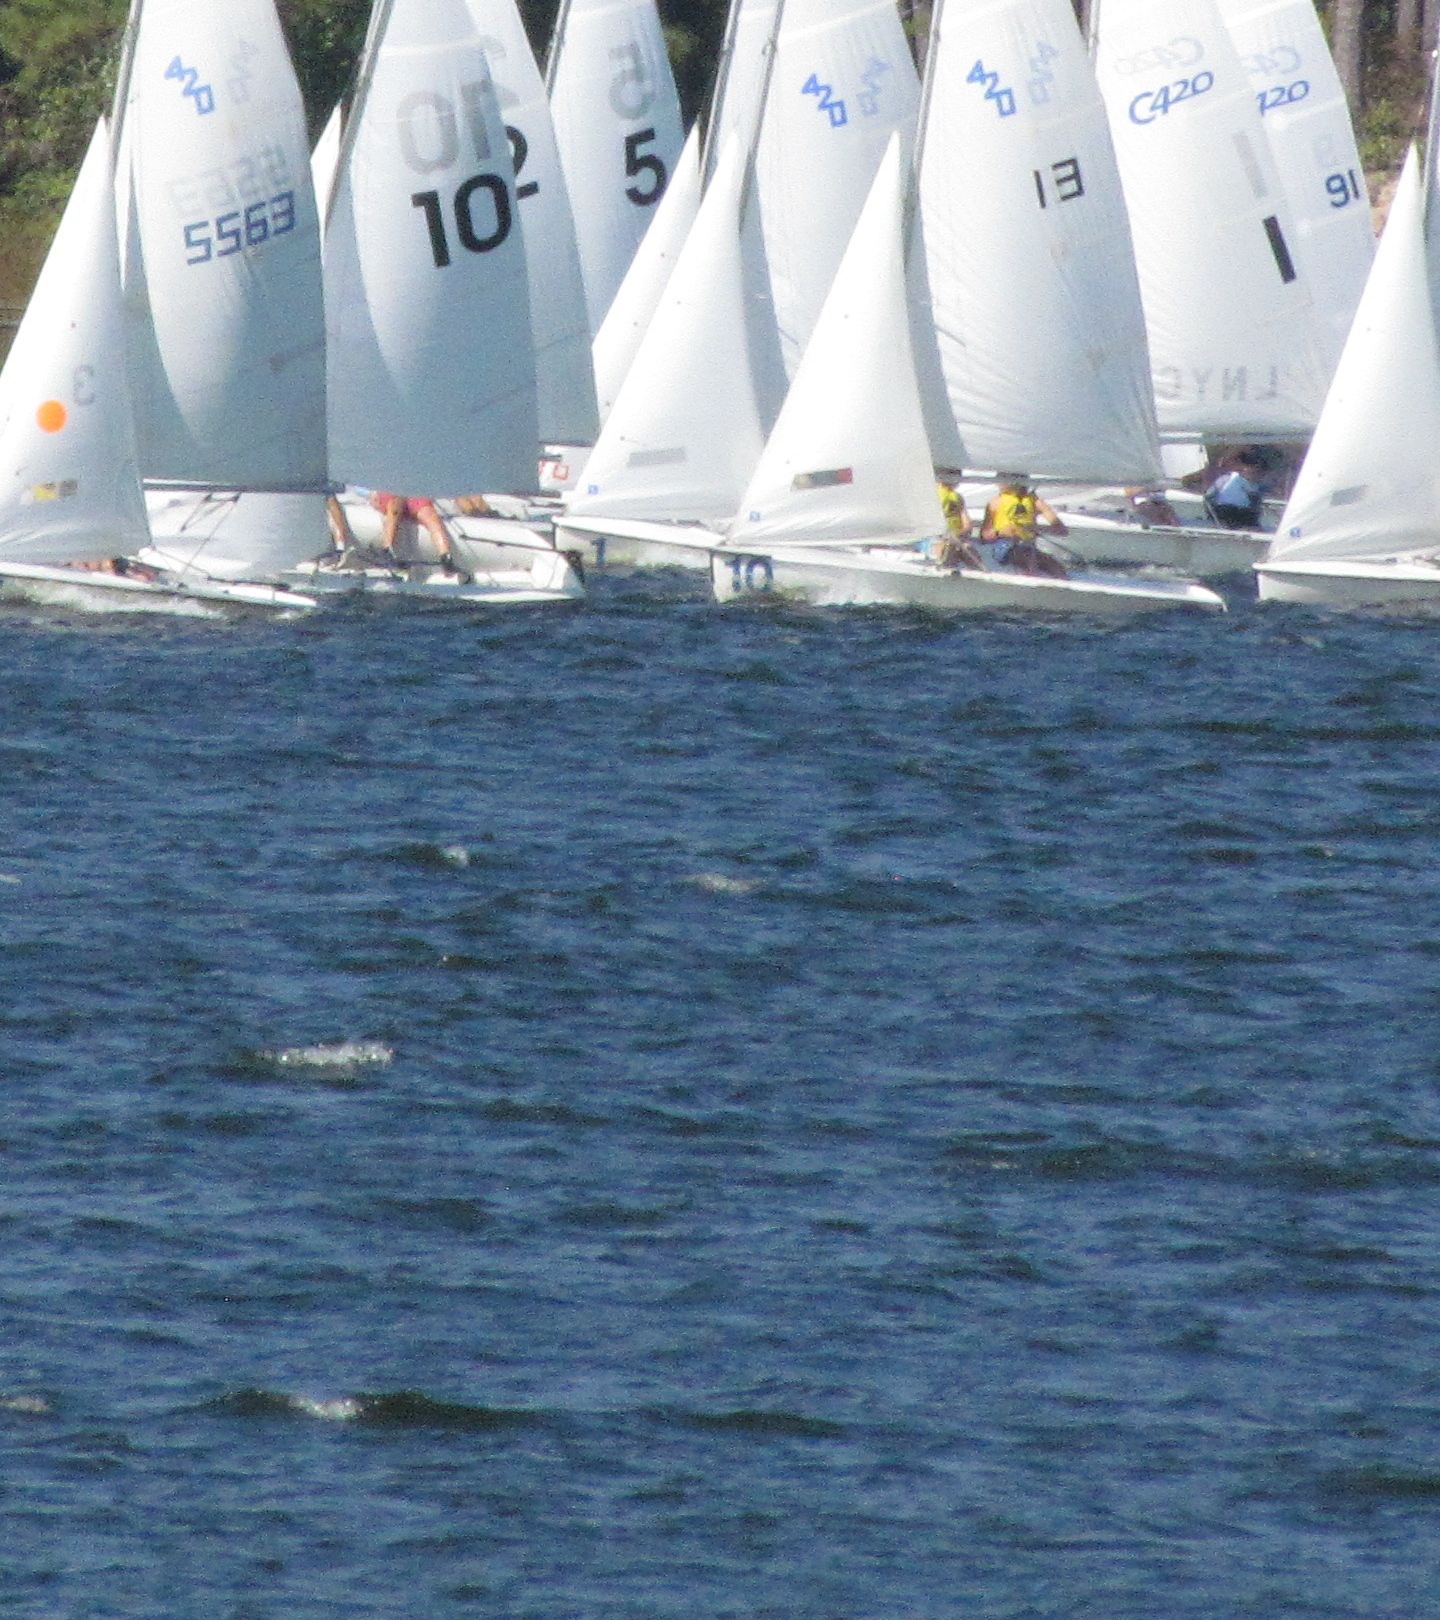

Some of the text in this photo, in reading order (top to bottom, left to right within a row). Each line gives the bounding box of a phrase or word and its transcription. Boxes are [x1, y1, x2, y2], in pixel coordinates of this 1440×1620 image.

[164, 56, 215, 115] 420
[801, 73, 848, 128] 420
[966, 59, 1016, 118] 420
[1129, 72, 1214, 124] C420
[624, 128, 667, 206] 5
[1033, 157, 1085, 209] 13
[1326, 169, 1360, 209] 91
[184, 190, 295, 265] 5563
[412, 174, 512, 269] 10
[1262, 215, 1296, 284] 1
